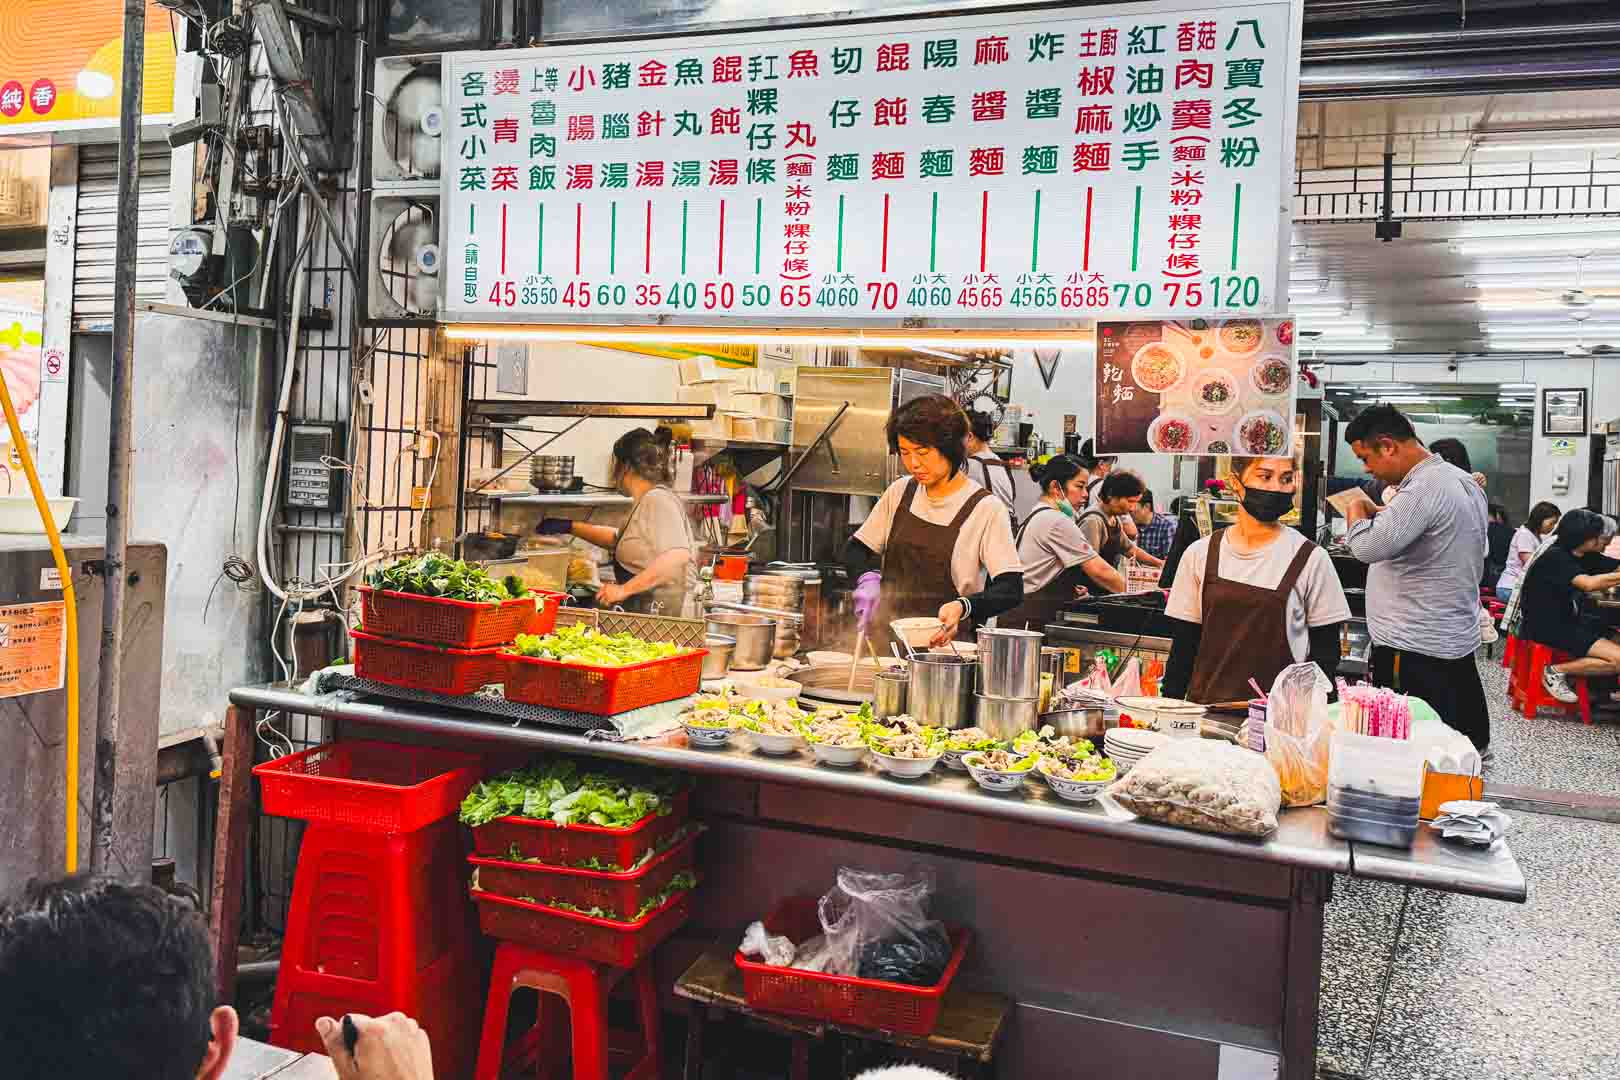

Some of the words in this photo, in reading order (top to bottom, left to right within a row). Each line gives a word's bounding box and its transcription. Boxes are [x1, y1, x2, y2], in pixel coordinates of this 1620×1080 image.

[969, 35, 1008, 176] 麻醬麵
[1022, 32, 1064, 175] 炸醬麵
[1121, 25, 1166, 171] 紅油炒手
[1220, 19, 1265, 168] 八寶冬粉
[827, 47, 862, 181] 切仔麵
[872, 43, 909, 180] 餛飩麵
[920, 39, 958, 178] 陽春麵
[460, 72, 488, 191] 各式小菜
[492, 69, 520, 191] 燙青菜
[566, 65, 595, 190] 小腸湯
[600, 62, 631, 188] 豬腦湯
[636, 60, 667, 187] 金針湯
[672, 58, 703, 187] 魚丸湯
[709, 56, 742, 186] 餛飩湯
[526, 276, 538, 285] 小
[541, 276, 552, 284] 大
[823, 275, 836, 284] 小
[841, 274, 854, 284] 大
[913, 274, 927, 284] 小
[932, 274, 946, 284] 大
[964, 274, 978, 284] 小
[983, 273, 998, 284] 大
[1017, 274, 1032, 284] 小
[1037, 273, 1052, 284] 大
[1067, 272, 1083, 284] 小
[1088, 273, 1104, 284] 大
[489, 282, 516, 306] 45
[522, 288, 538, 304] 35
[541, 288, 557, 304] 50
[562, 282, 590, 307] 45
[598, 285, 625, 305] 60
[636, 285, 661, 305] 35
[666, 282, 696, 309] 40
[704, 282, 734, 309] 50
[742, 285, 770, 306] 50
[781, 285, 811, 307] 65
[816, 288, 836, 307] 40
[839, 288, 858, 306] 60
[867, 282, 897, 310] 70
[907, 288, 927, 306] 40
[931, 288, 951, 305] 60
[957, 288, 978, 307] 45
[981, 288, 1002, 307] 65
[1010, 288, 1031, 307] 45
[1035, 287, 1056, 307] 65
[1061, 287, 1083, 307] 65
[1086, 287, 1108, 307] 85
[1114, 283, 1151, 307] 70
[1163, 283, 1202, 307] 75
[1210, 276, 1259, 307] 120
